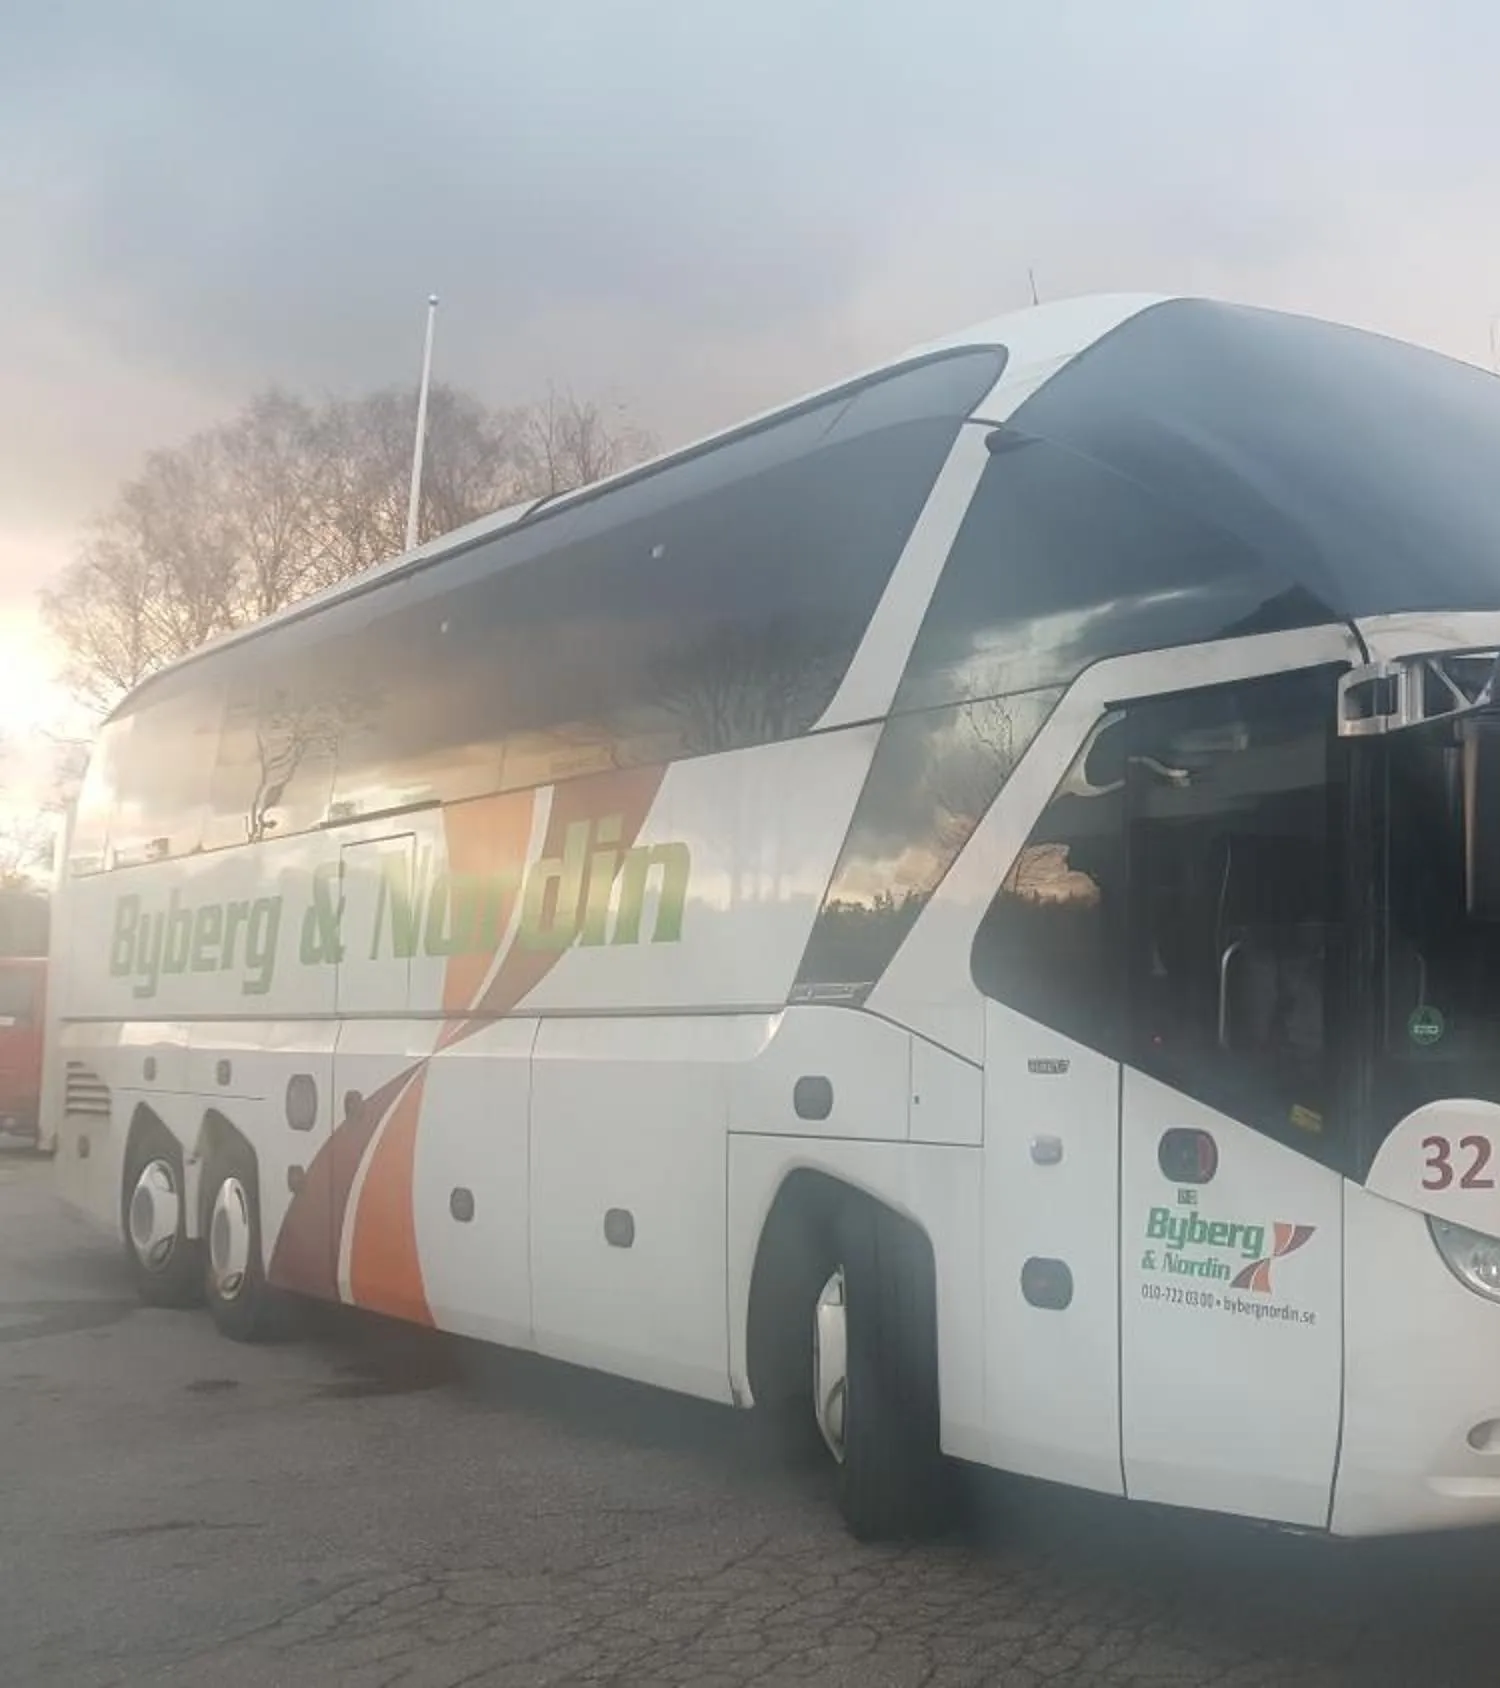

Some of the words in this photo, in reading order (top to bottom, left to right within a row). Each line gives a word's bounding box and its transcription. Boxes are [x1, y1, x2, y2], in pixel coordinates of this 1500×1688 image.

[109, 887, 283, 998] Byberg
[300, 858, 346, 965] &
[369, 814, 691, 961] Nordin
[1420, 1135, 1495, 1191] 32
[1146, 1207, 1265, 1260] Byberg
[1141, 1249, 1156, 1270] &
[1162, 1251, 1232, 1281] Nordin
[1141, 1283, 1183, 1304] 010-722
[1222, 1298, 1316, 1325] bybergnordin.se
